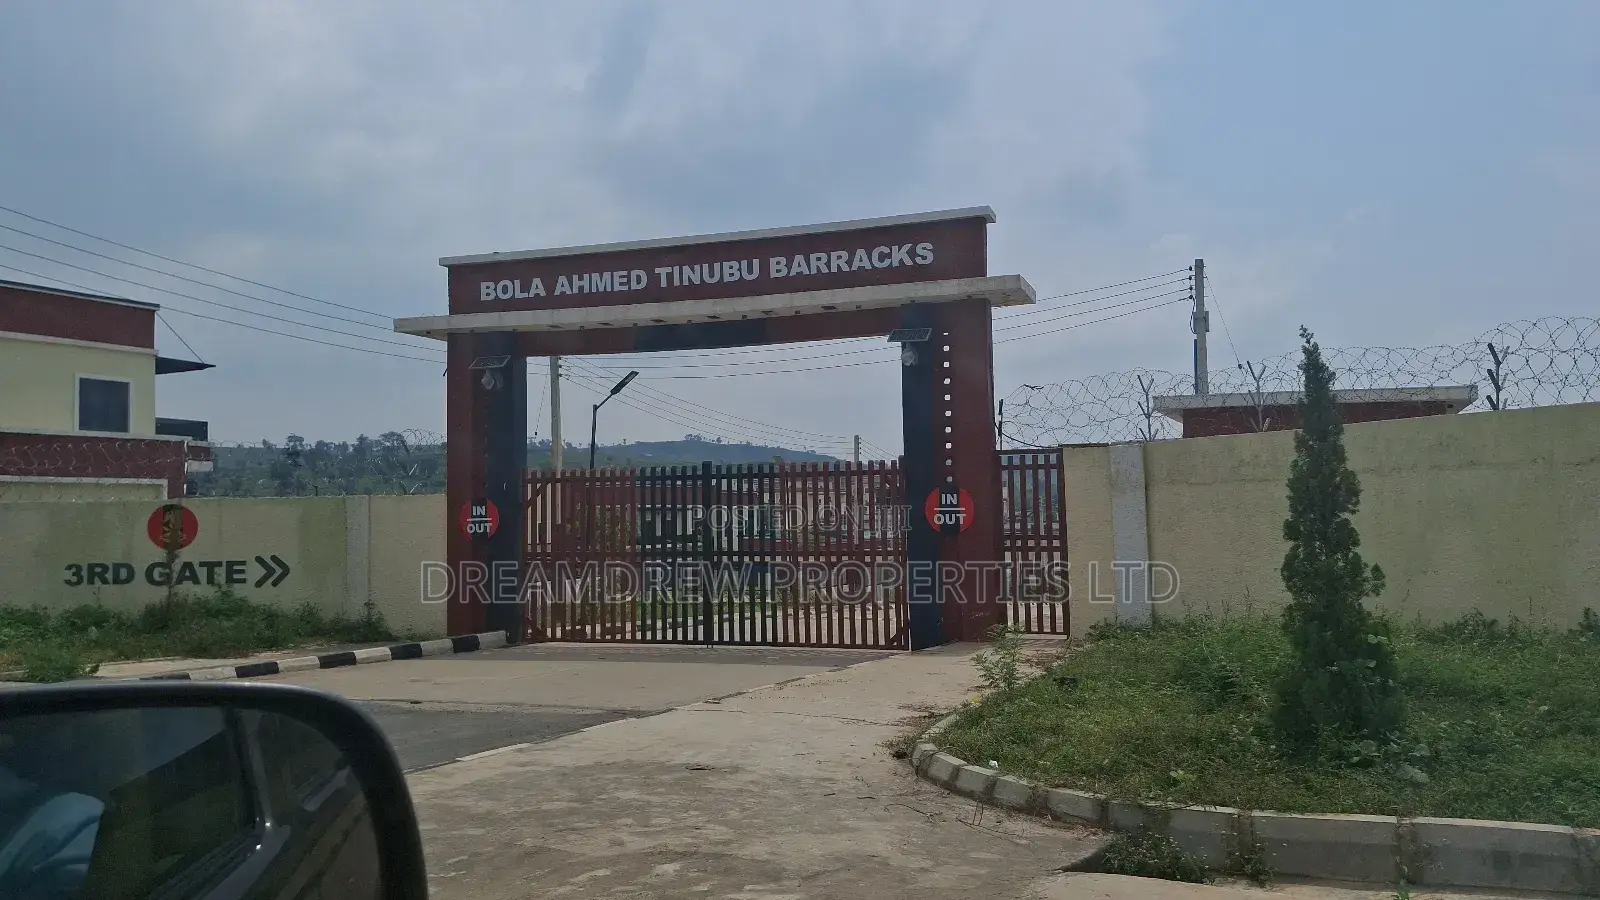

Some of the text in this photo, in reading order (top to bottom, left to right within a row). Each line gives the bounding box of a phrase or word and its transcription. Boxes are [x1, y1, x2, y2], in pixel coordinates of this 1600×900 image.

[479, 242, 935, 301] BOLA AHMED TINUBU BARRACKS
[941, 493, 958, 505] IN
[472, 505, 486, 516] IN
[933, 513, 967, 525] OUT
[466, 523, 493, 534] OUT
[63, 560, 248, 587] 3RD GATE
